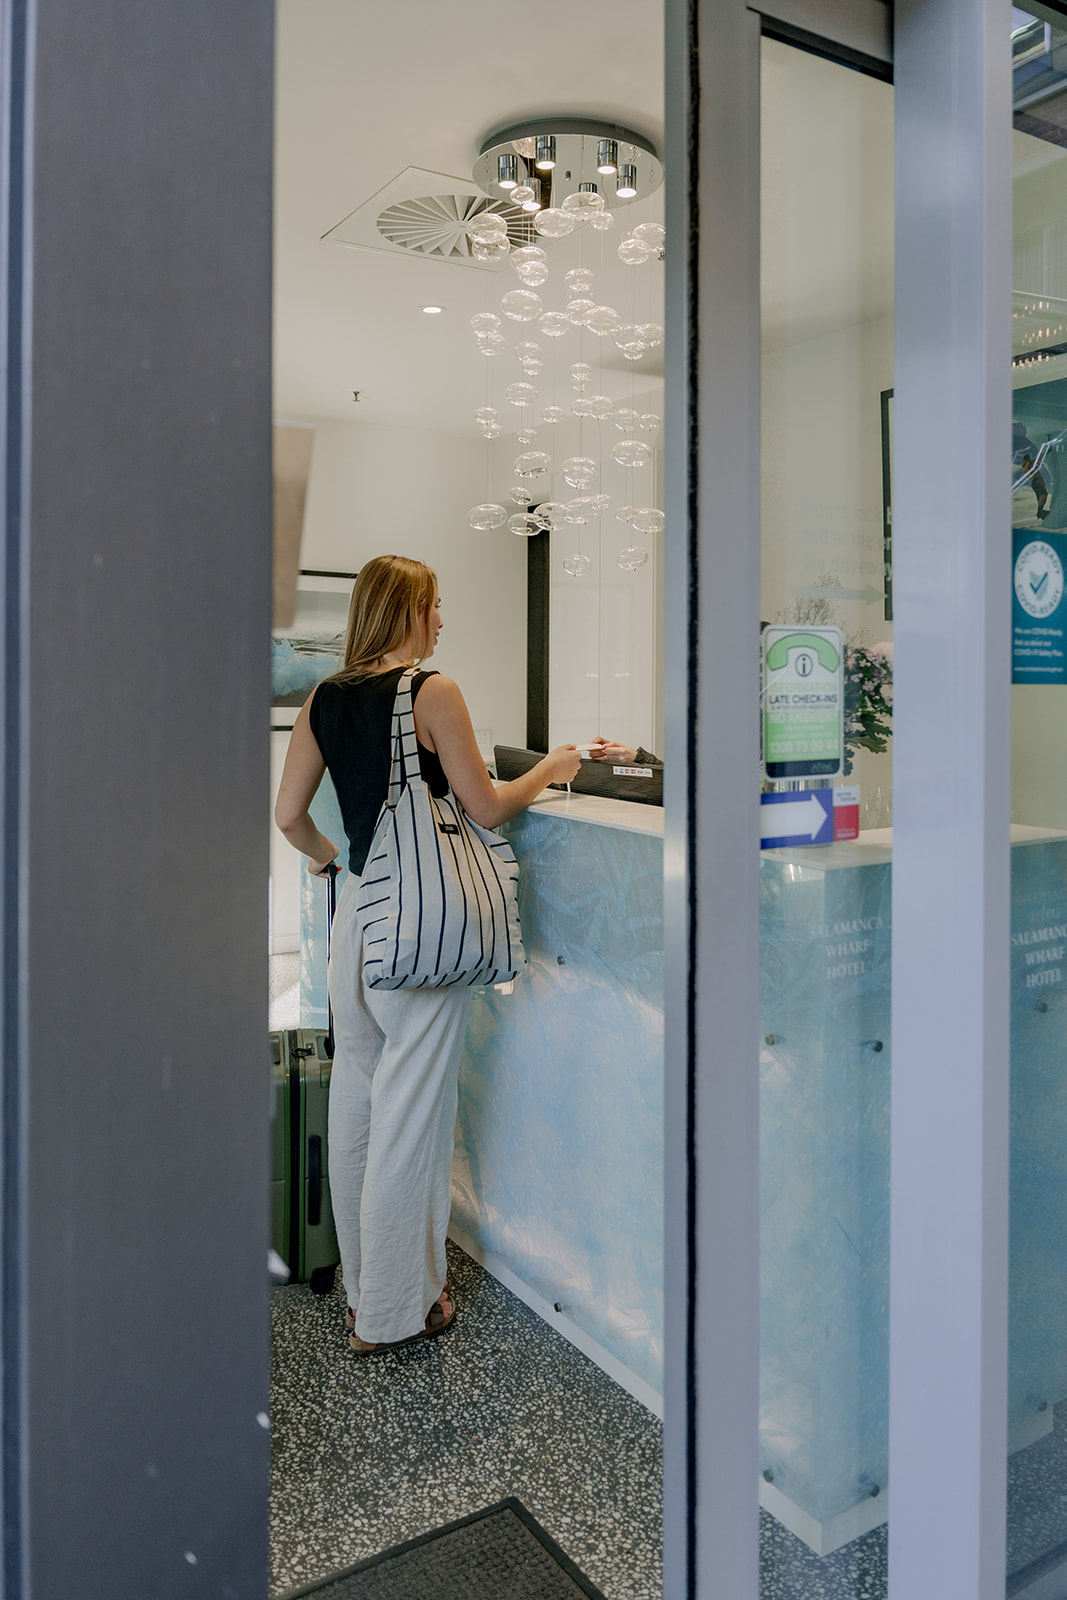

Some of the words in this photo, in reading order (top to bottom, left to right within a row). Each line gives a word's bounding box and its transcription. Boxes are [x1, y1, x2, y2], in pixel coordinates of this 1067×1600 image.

[769, 694, 790, 704] LATE
[809, 916, 883, 938] SALAMANCA
[825, 939, 871, 957] WHARF
[1025, 946, 1065, 966] WHARF
[826, 961, 867, 980] HOTEL
[1026, 968, 1063, 988] HOTEL
